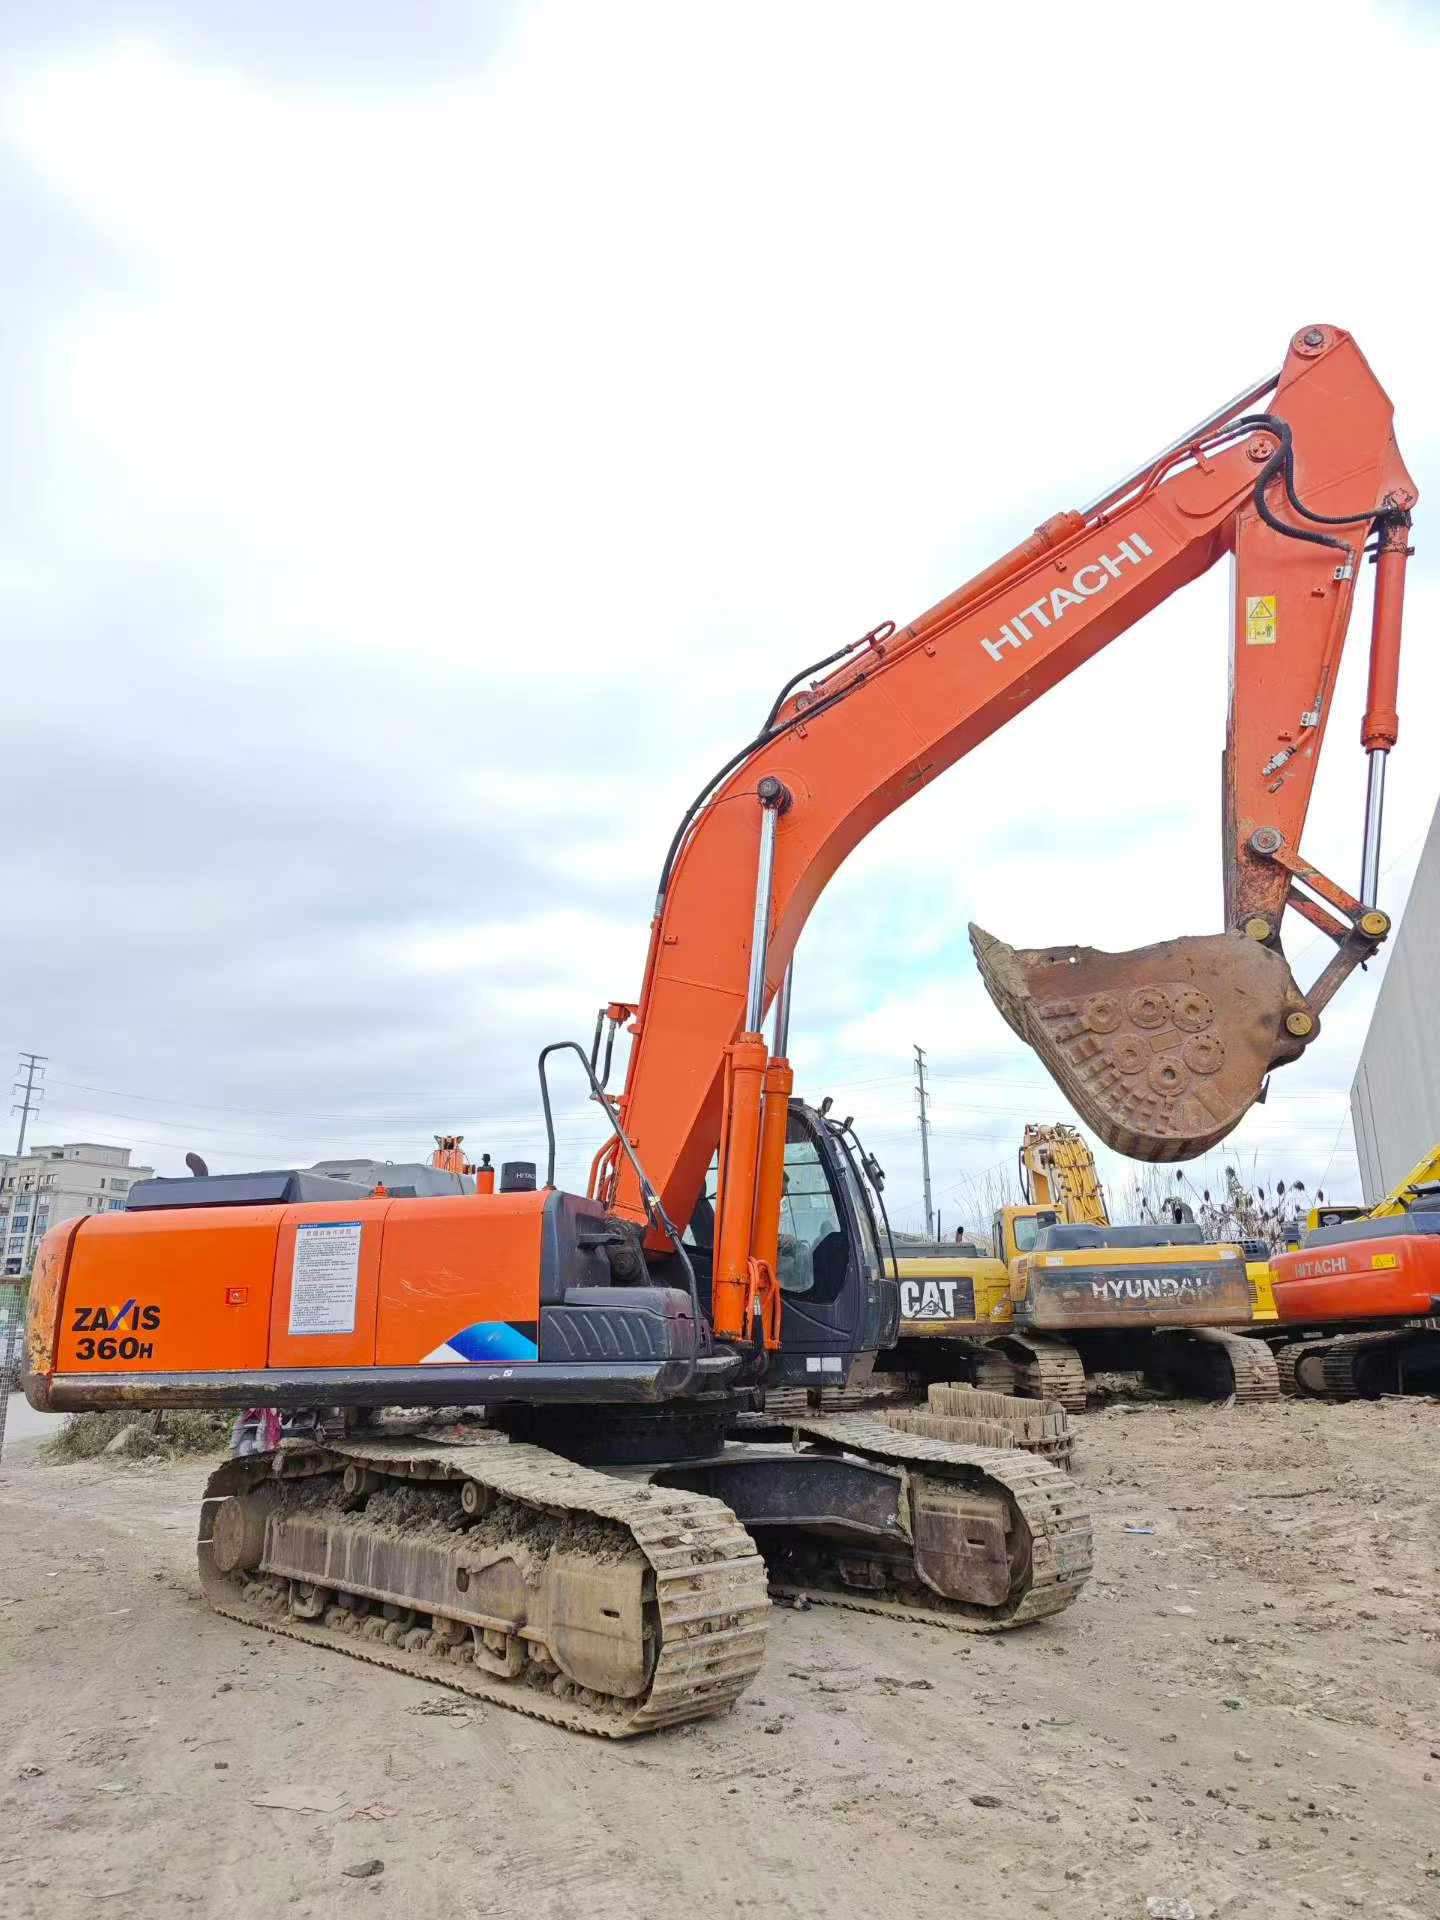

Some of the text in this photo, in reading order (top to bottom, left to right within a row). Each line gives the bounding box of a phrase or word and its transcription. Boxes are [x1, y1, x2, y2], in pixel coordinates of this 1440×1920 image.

[980, 532, 1153, 662] HITACHI
[1295, 1256, 1347, 1279] HITACHI
[900, 1280, 958, 1319] CAT
[1091, 1277, 1202, 1299] HYUNDAI
[72, 1298, 161, 1331] ZAXIS
[76, 1337, 154, 1360] 360H
